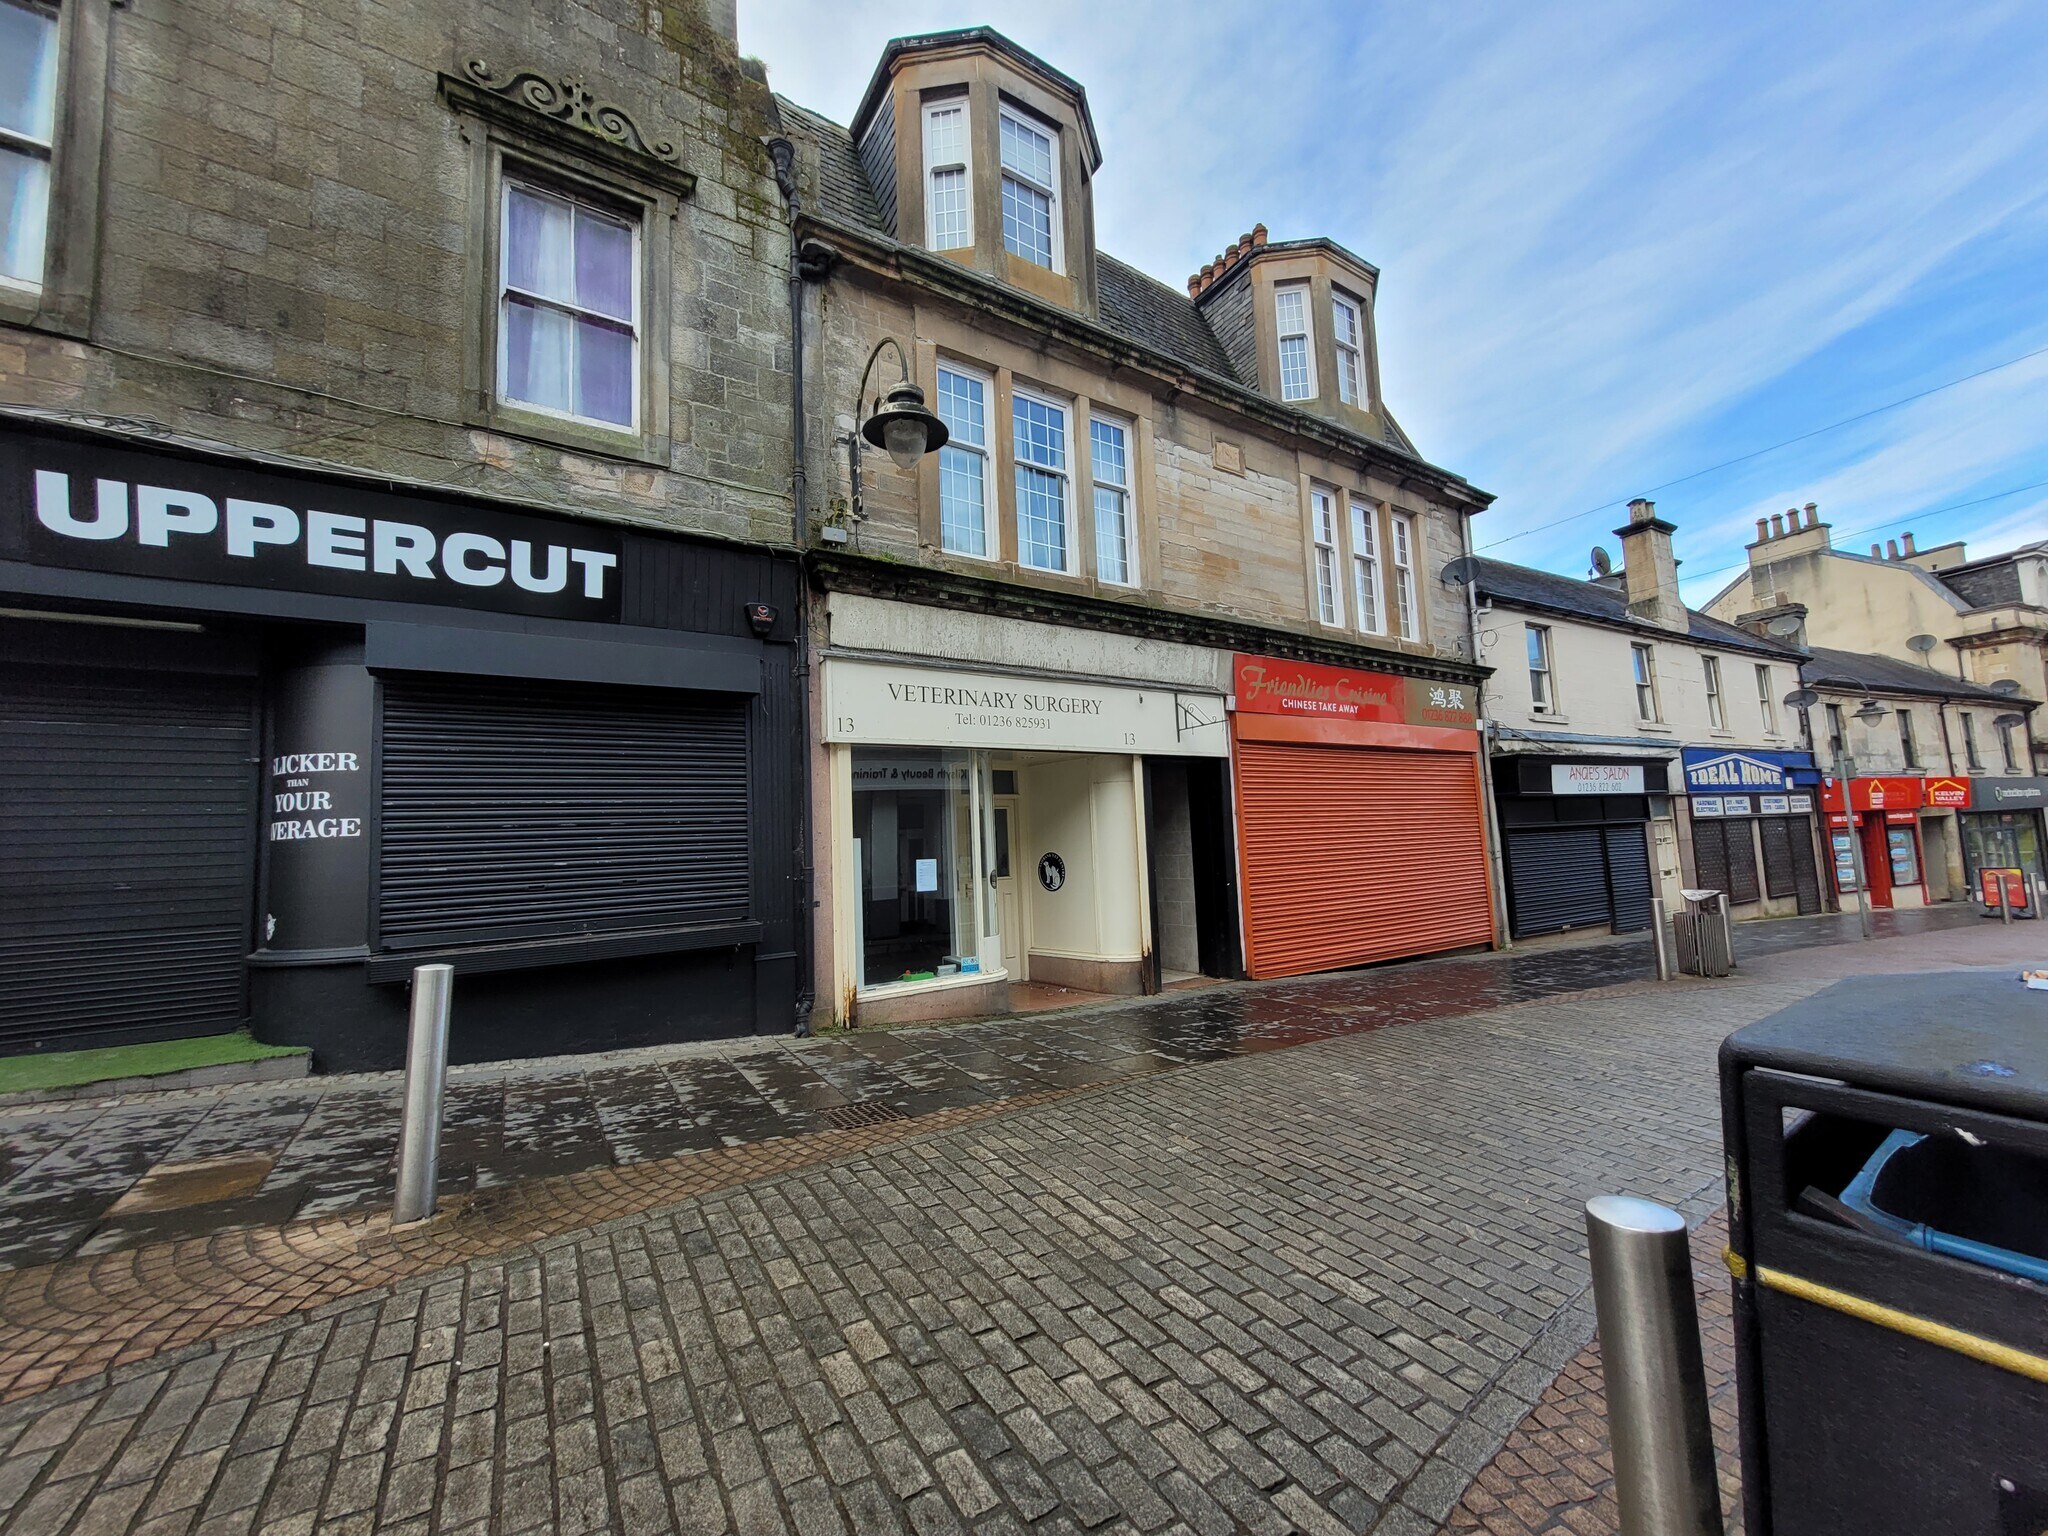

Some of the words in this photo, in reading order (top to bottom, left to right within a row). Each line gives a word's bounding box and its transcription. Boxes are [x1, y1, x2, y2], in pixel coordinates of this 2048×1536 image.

[35, 469, 617, 599] UPPERCUT
[1240, 665, 1330, 700] Friendlies
[888, 683, 1018, 710] VETERINARY
[1023, 694, 1102, 715] SURGERY
[1282, 698, 1317, 711] CHINESE
[1318, 702, 1337, 713] TAKE
[1338, 704, 1359, 714] AWAY
[1429, 687, 1465, 710] 鸿聚
[837, 717, 855, 733] 13
[955, 713, 976, 725] Tel:
[979, 715, 1012, 728] 01236
[1015, 717, 1051, 730] 825931
[1123, 732, 1136, 746] 13
[1603, 767, 1630, 780] SALON
[1690, 760, 1740, 785] IDEAL
[1740, 760, 1782, 785] HOME
[287, 778, 309, 787] THAN
[275, 791, 332, 813] YOUR
